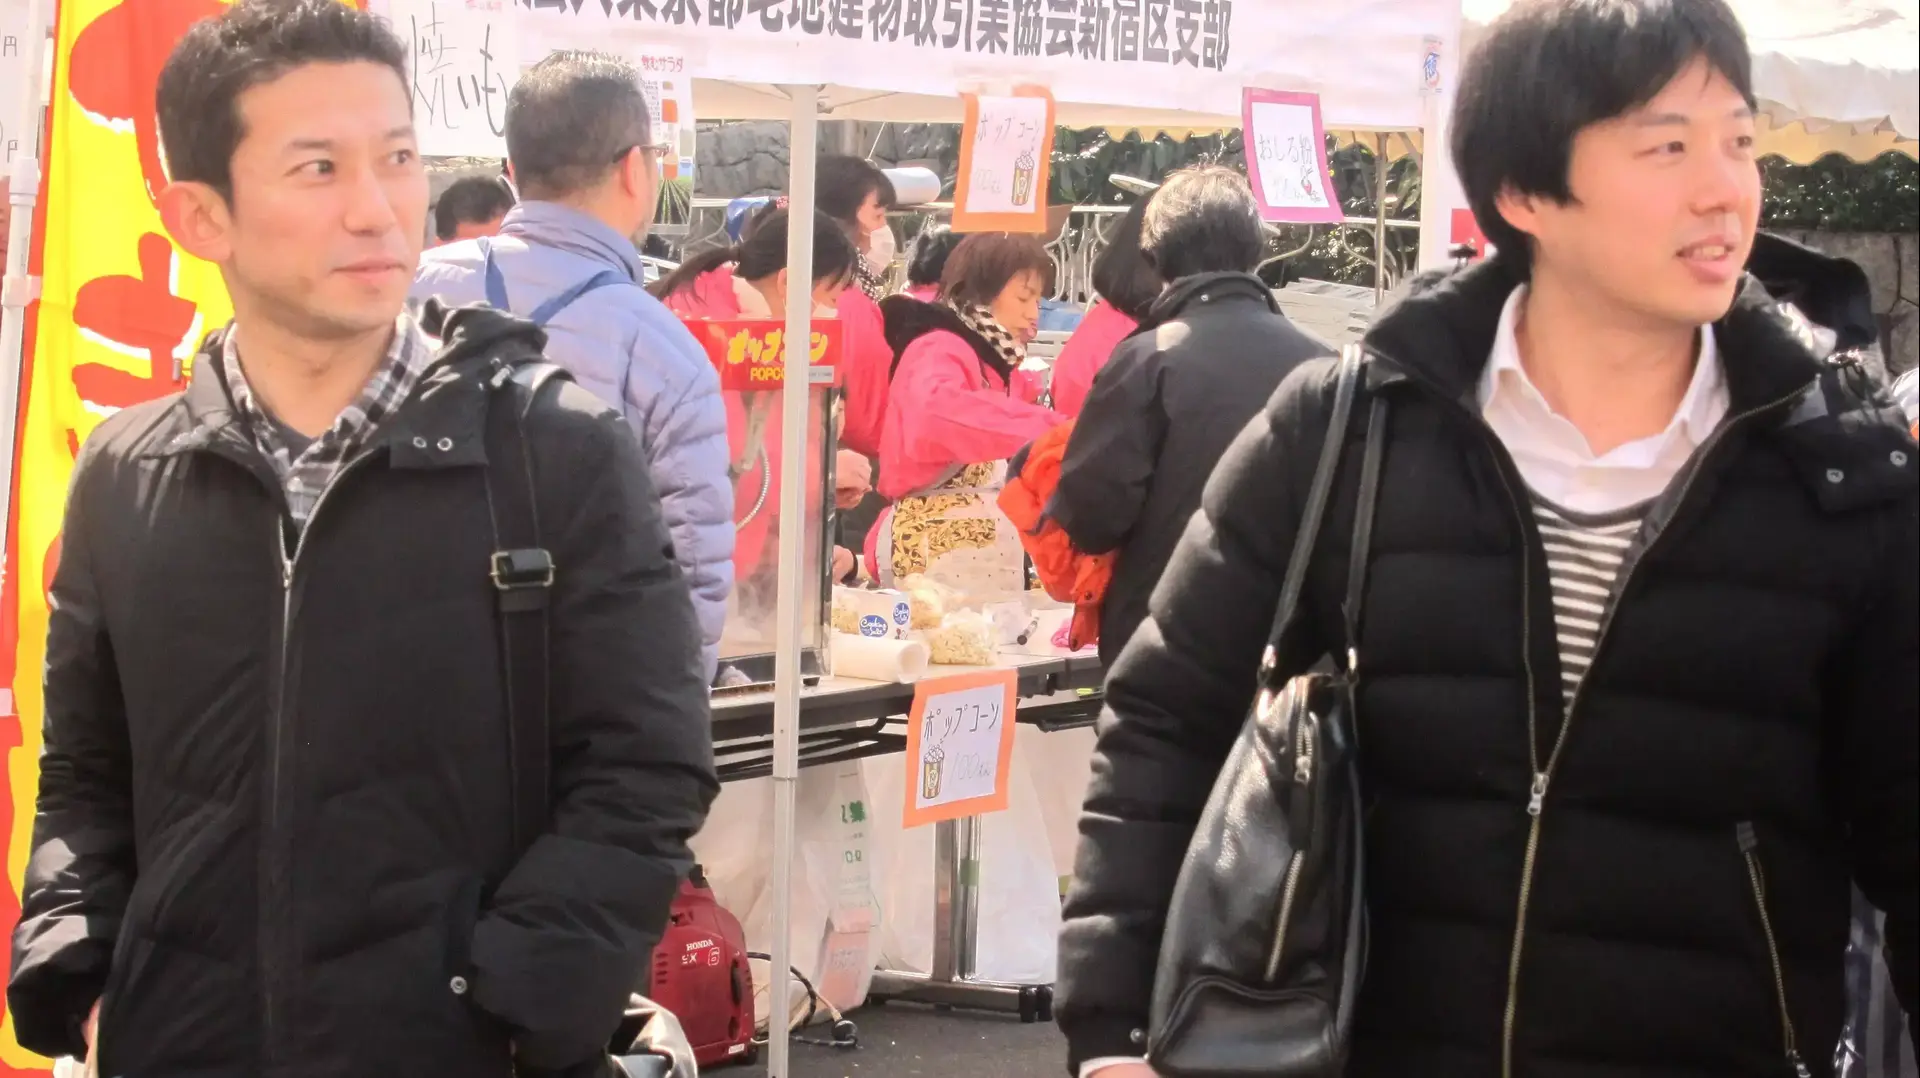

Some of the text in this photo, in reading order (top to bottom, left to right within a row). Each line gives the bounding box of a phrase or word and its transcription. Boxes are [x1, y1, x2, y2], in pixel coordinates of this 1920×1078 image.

[924, 703, 999, 742] ポップコーン
[686, 939, 714, 951] HONDA
